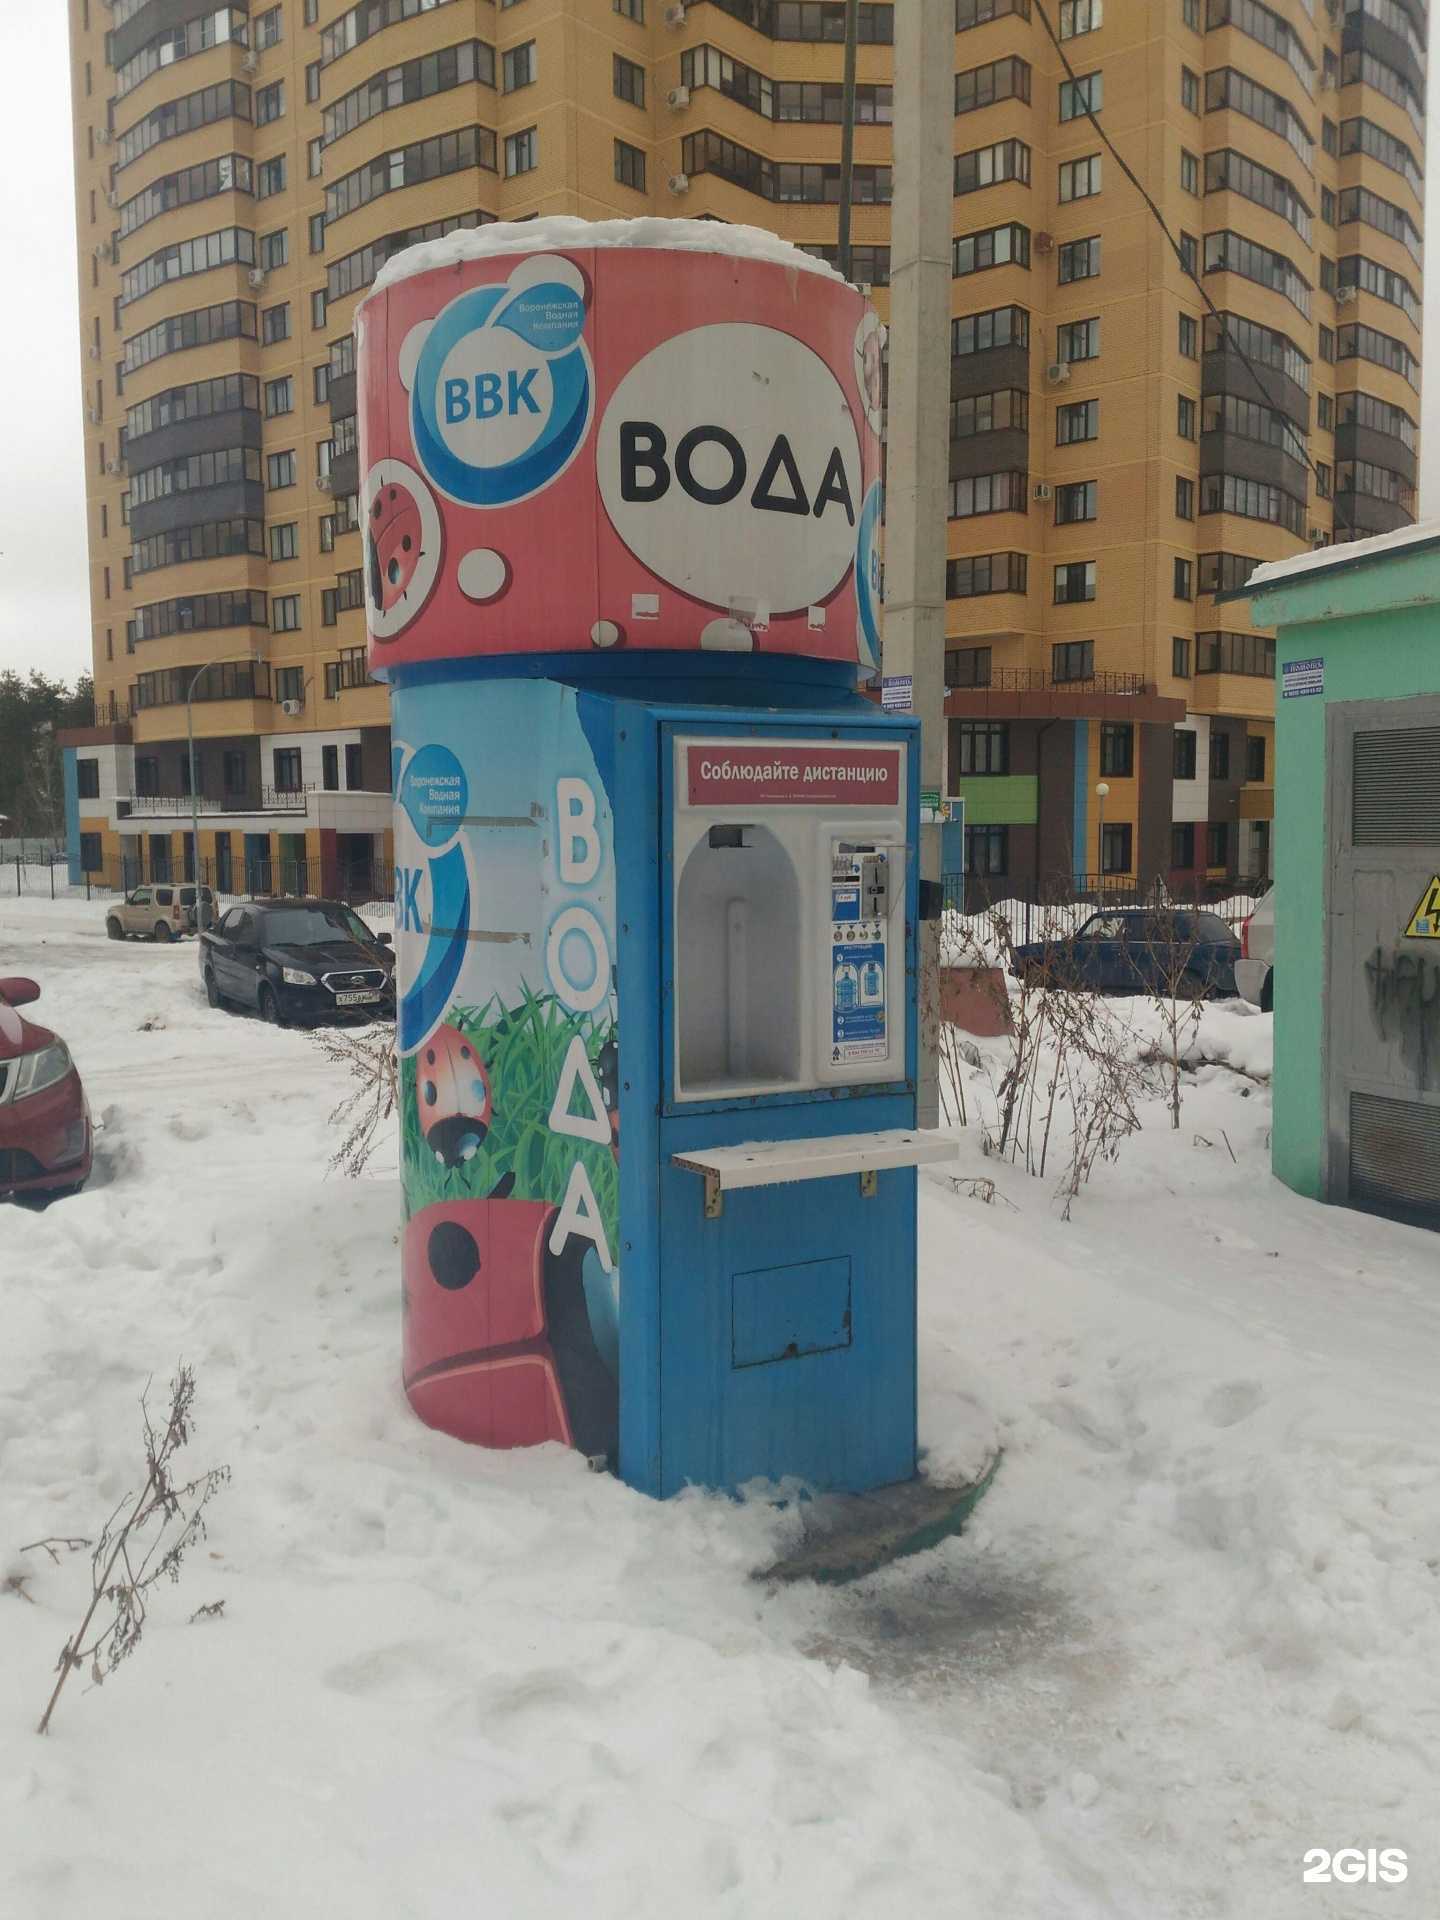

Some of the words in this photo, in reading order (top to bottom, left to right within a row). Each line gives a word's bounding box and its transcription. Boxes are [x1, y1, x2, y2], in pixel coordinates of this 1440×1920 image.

[444, 367, 541, 425] ВВК
[619, 420, 856, 527] ВОДА
[429, 787, 461, 802] Водная
[701, 760, 799, 783] Соблюдайте
[803, 764, 888, 783] дистанцию
[547, 777, 612, 1274] ВОДА
